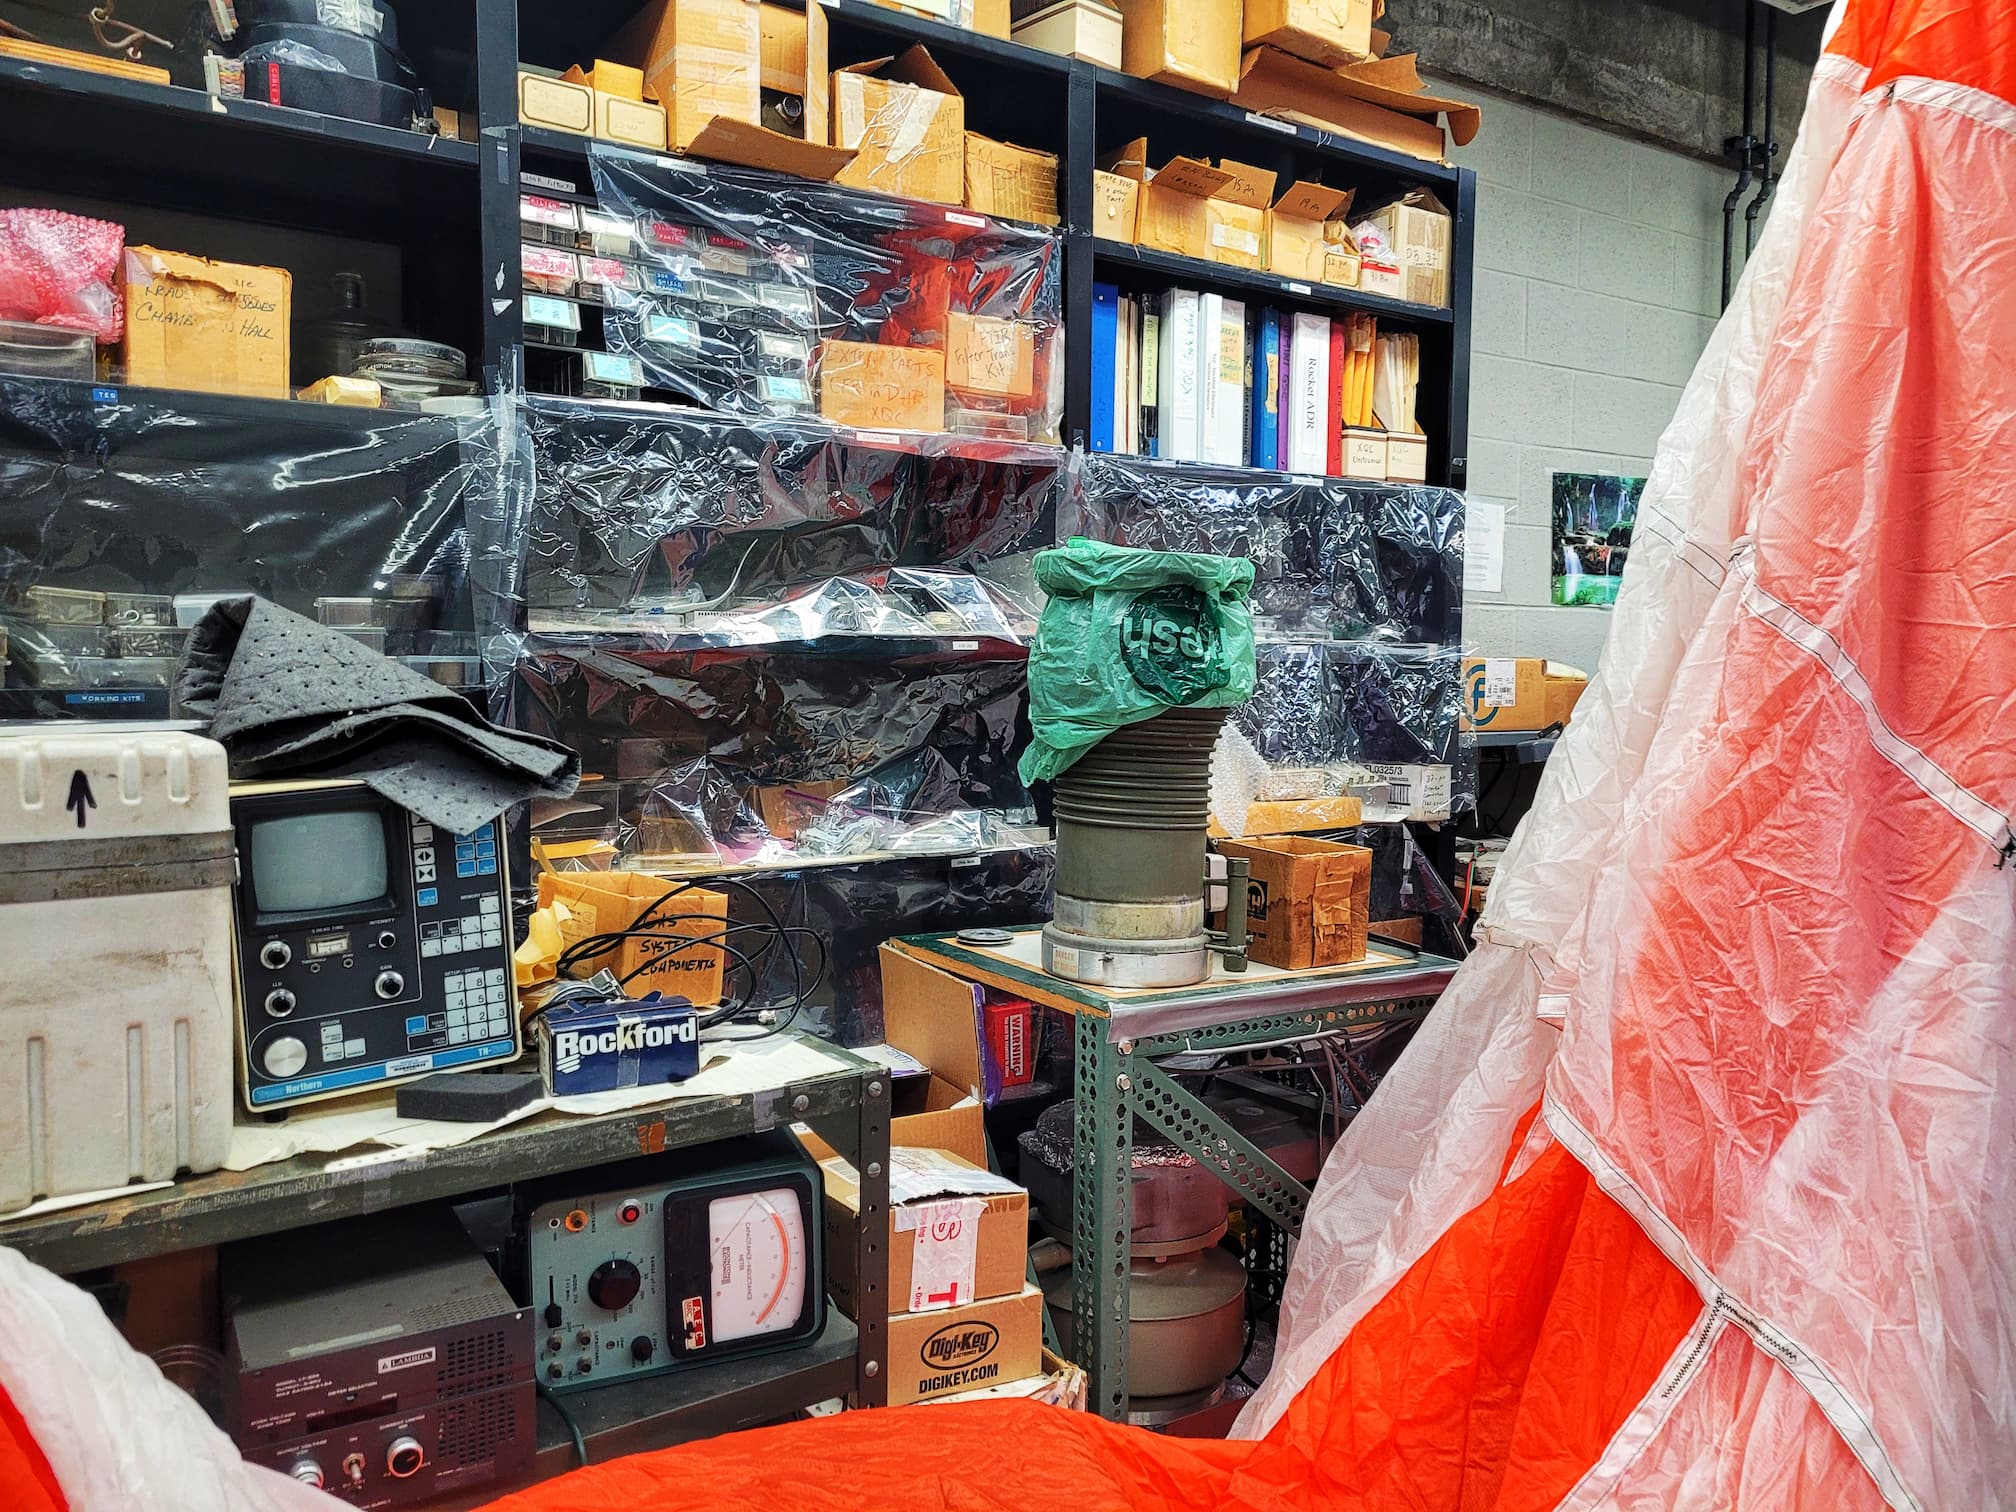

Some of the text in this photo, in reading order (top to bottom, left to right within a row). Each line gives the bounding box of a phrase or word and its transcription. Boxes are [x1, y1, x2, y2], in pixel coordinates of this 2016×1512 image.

[239, 317, 274, 339] HALL
[1306, 358, 1317, 430] Rocket ADR
[81, 694, 142, 702] WORKING KITS
[476, 978, 483, 987] 8
[496, 974, 503, 984] 9
[456, 981, 462, 990] 7
[478, 994, 484, 1003] 5
[497, 991, 504, 1000] 6
[457, 998, 464, 1007] 4
[479, 1012, 485, 1021] 2
[498, 1008, 505, 1017] 3
[480, 1028, 486, 1037] 0
[556, 1017, 697, 1061] Rockford
[1011, 1015, 1021, 1075] WARNING
[286, 1080, 322, 1094] Northern
[392, 1352, 430, 1367] LAMBDA
[918, 1363, 999, 1394] DIGIKEY.COM
